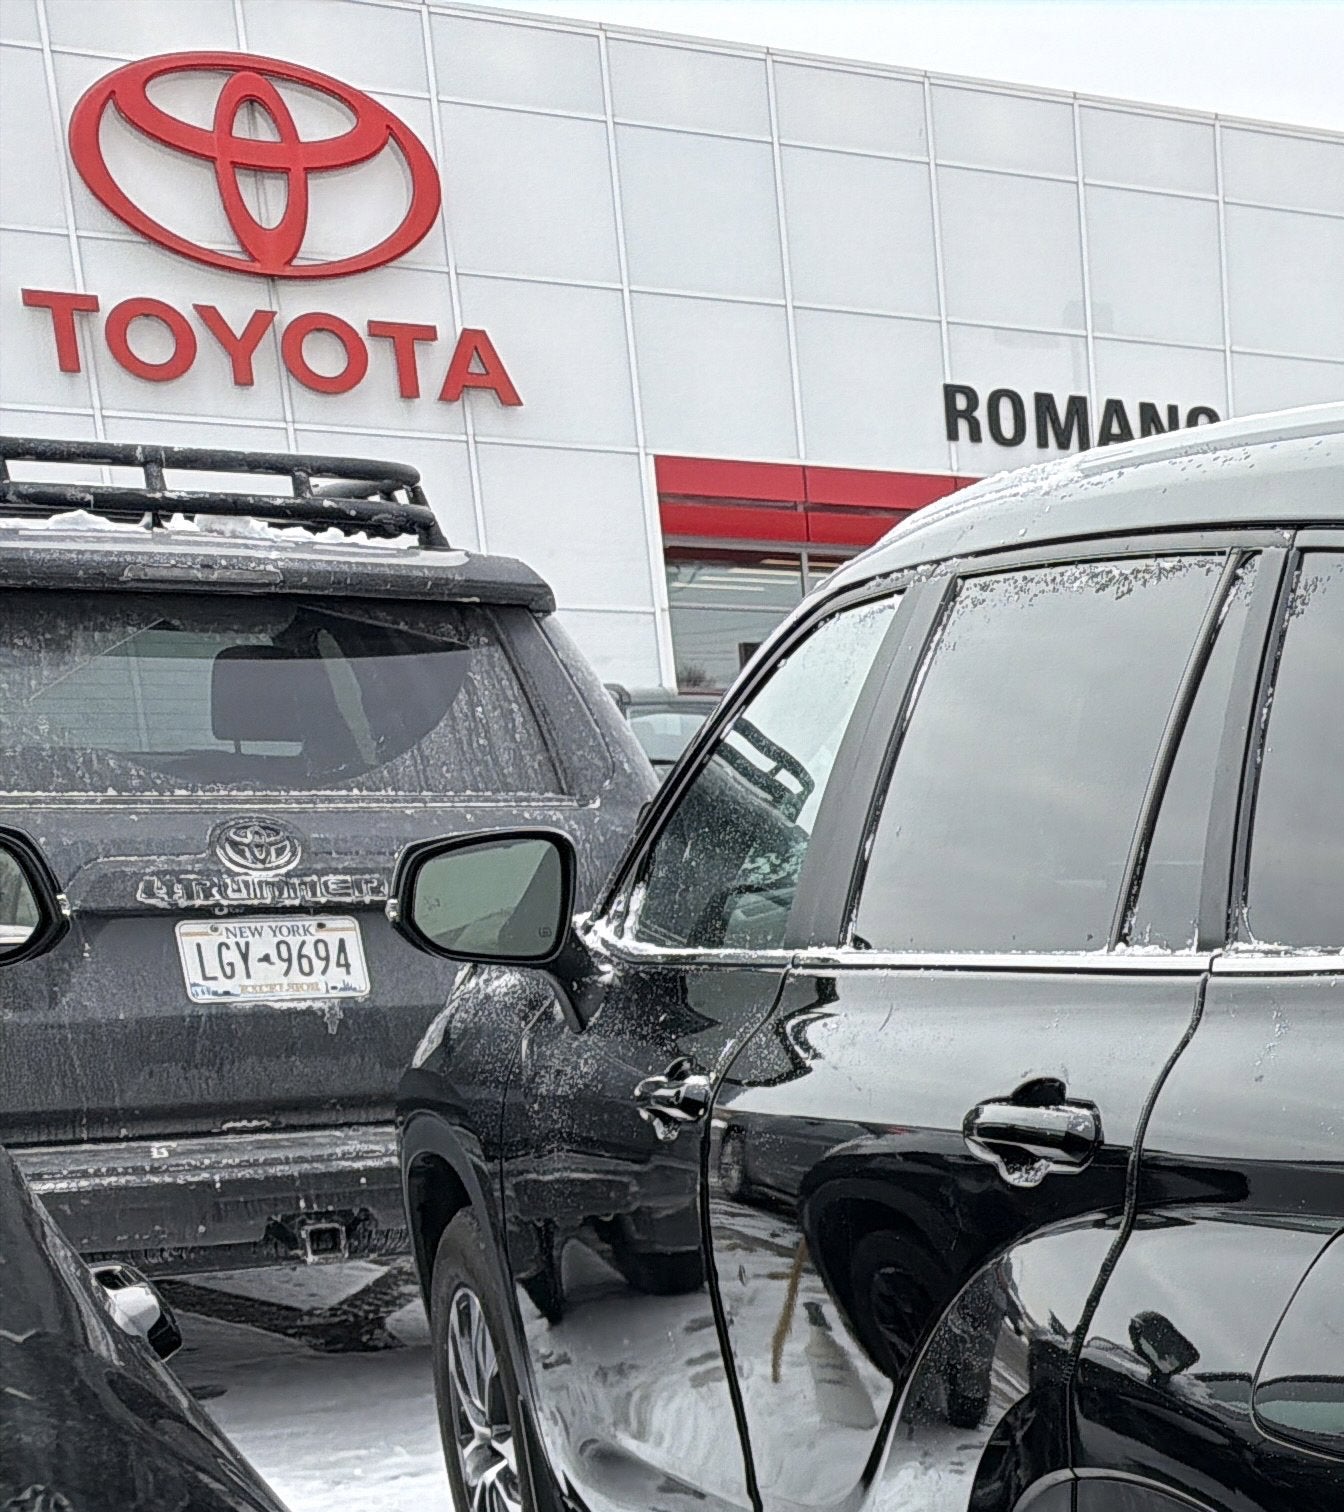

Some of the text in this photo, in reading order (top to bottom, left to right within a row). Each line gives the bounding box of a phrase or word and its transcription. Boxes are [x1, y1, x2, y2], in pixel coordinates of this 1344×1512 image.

[21, 288, 524, 407] TOYOTA
[224, 923, 315, 939] NEW YORK
